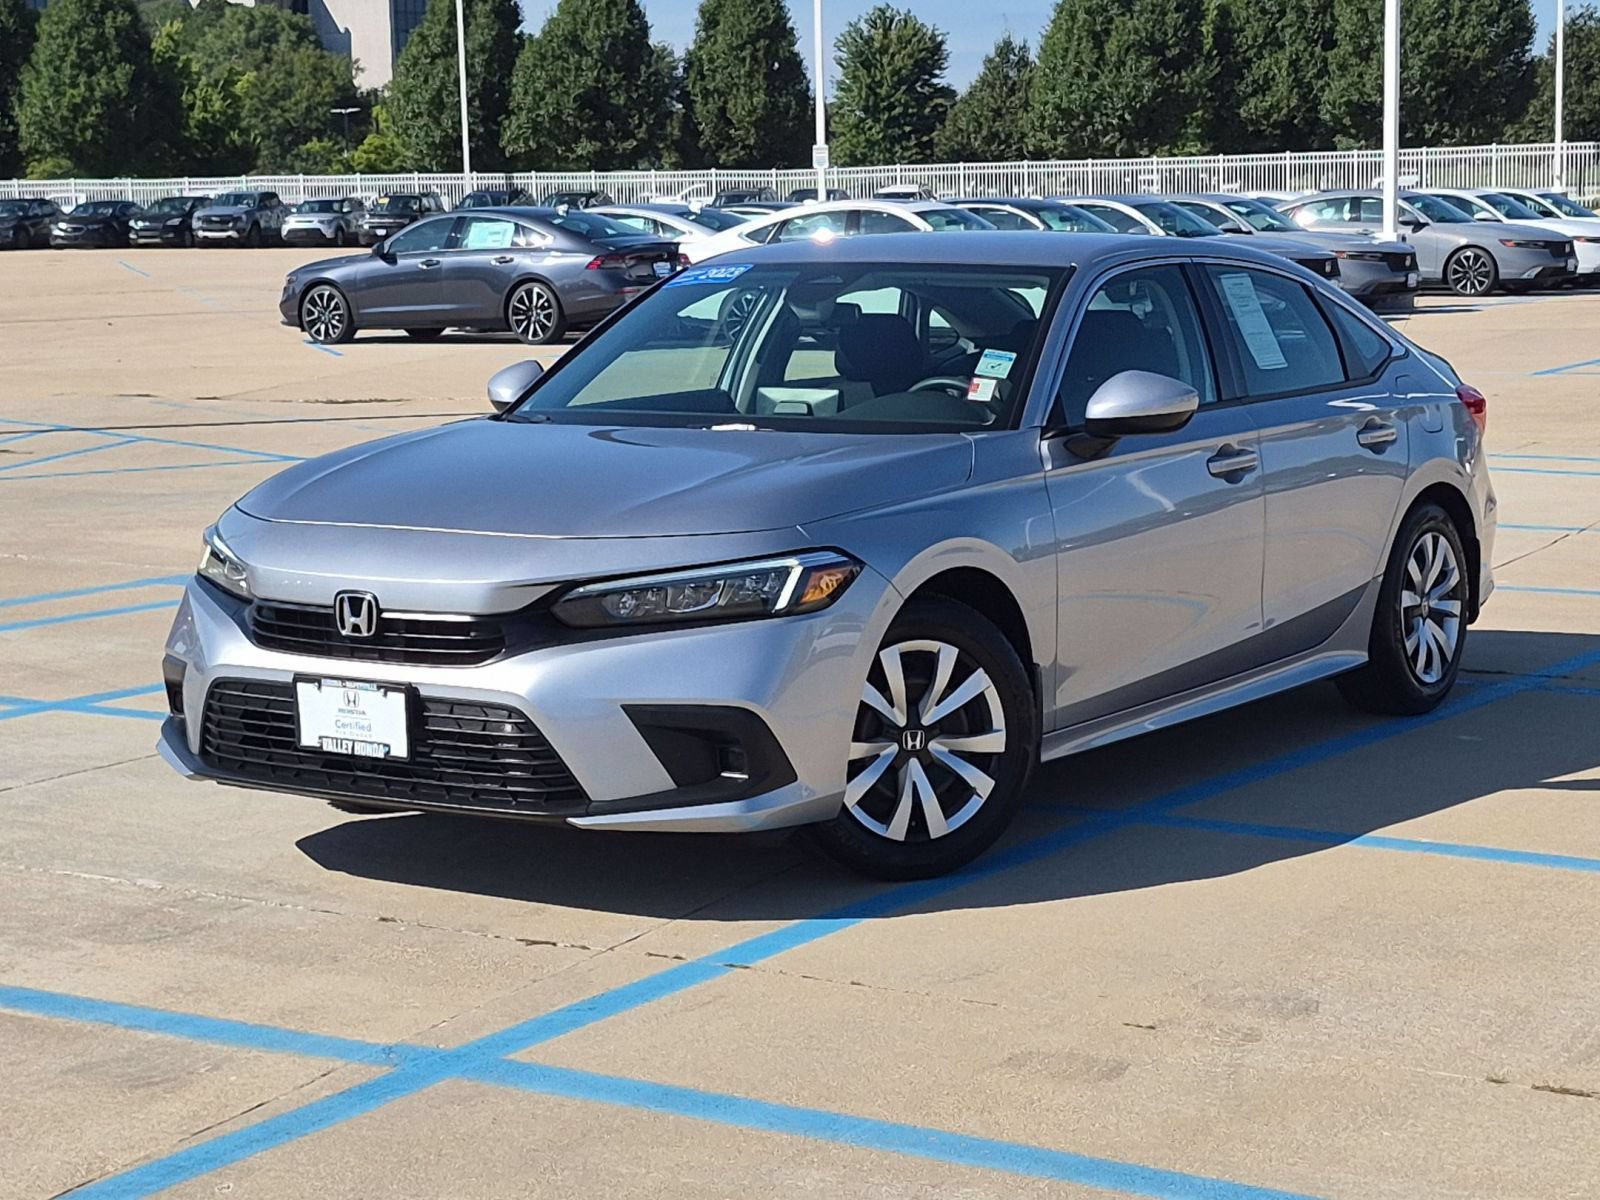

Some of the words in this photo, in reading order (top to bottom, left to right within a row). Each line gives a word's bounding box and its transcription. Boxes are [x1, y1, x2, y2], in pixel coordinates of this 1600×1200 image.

[335, 719, 372, 732] Certified
[322, 737, 353, 754] VALLEY
[354, 741, 385, 758] HONDA
